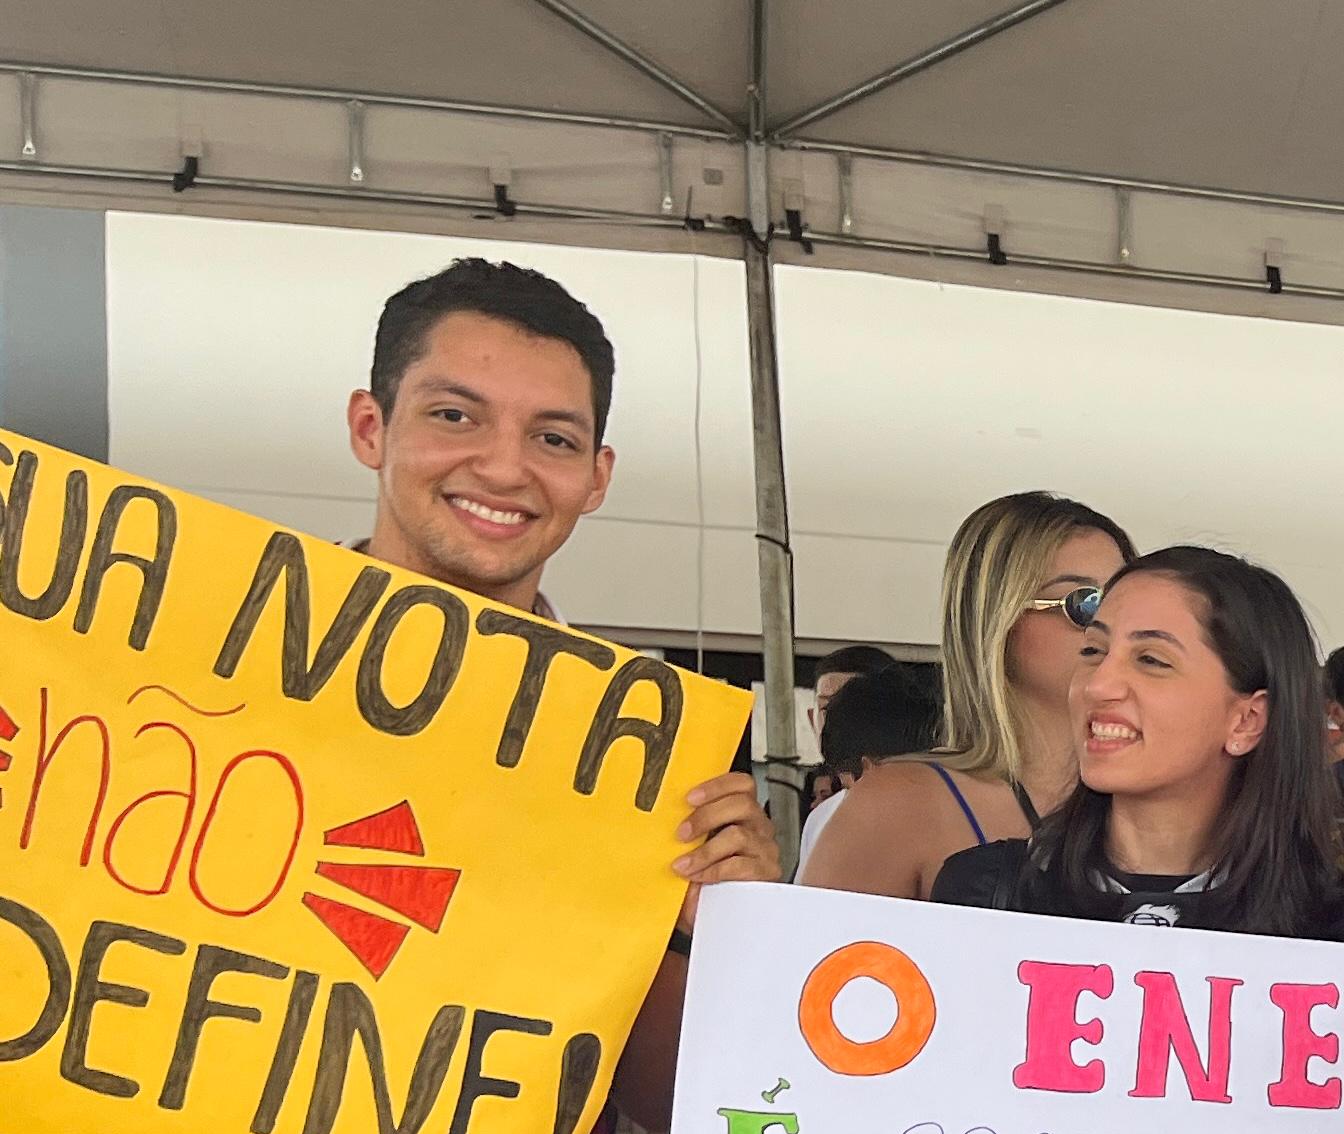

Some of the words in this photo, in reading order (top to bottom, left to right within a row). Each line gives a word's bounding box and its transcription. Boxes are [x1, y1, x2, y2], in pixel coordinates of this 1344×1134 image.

[212, 531, 684, 812] NOTA
[19, 685, 304, 916] não
[799, 940, 936, 1076] O
